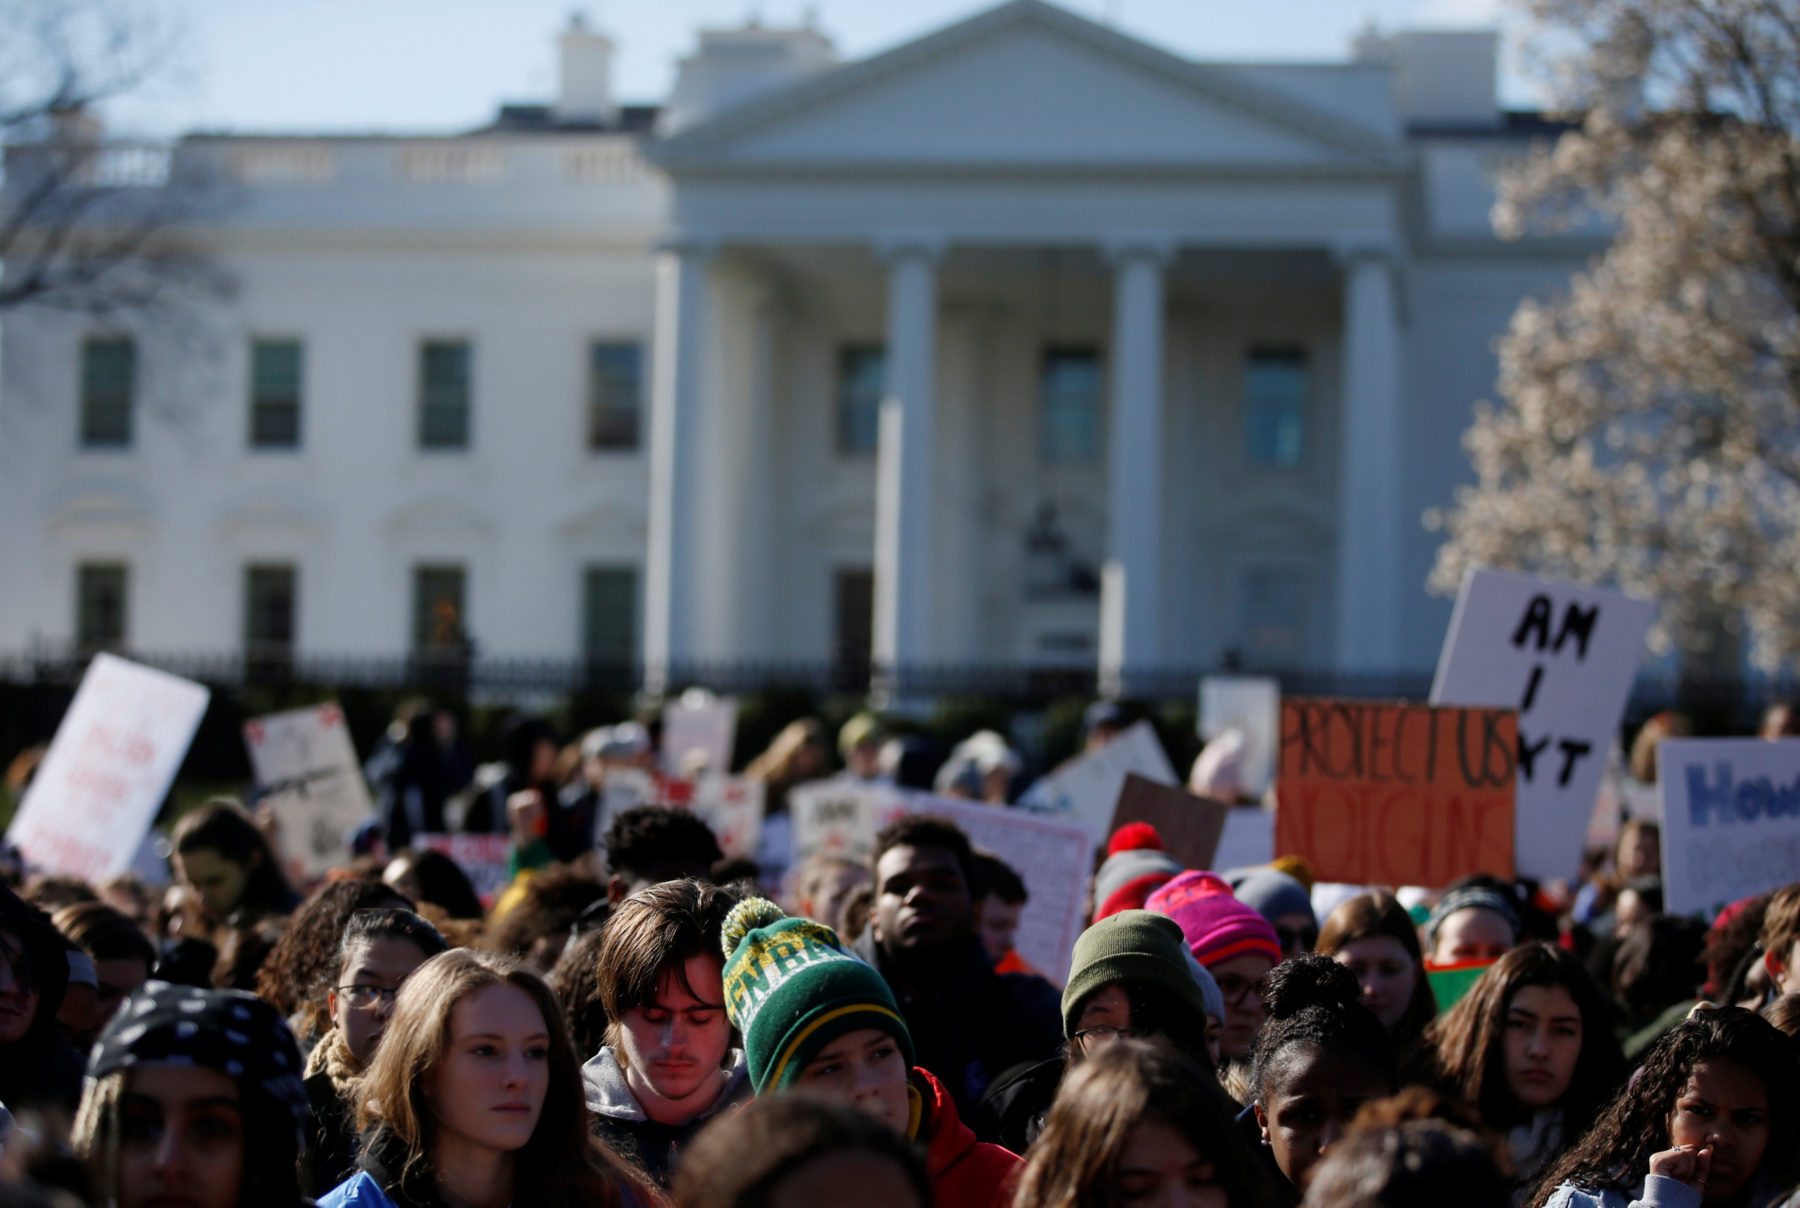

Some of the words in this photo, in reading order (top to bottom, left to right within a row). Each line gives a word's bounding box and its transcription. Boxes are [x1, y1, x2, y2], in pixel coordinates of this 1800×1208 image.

[1512, 595, 1600, 659] AM
[1521, 665, 1544, 711] I
[1281, 701, 1446, 784] PROTECT
[1456, 706, 1516, 789] US
